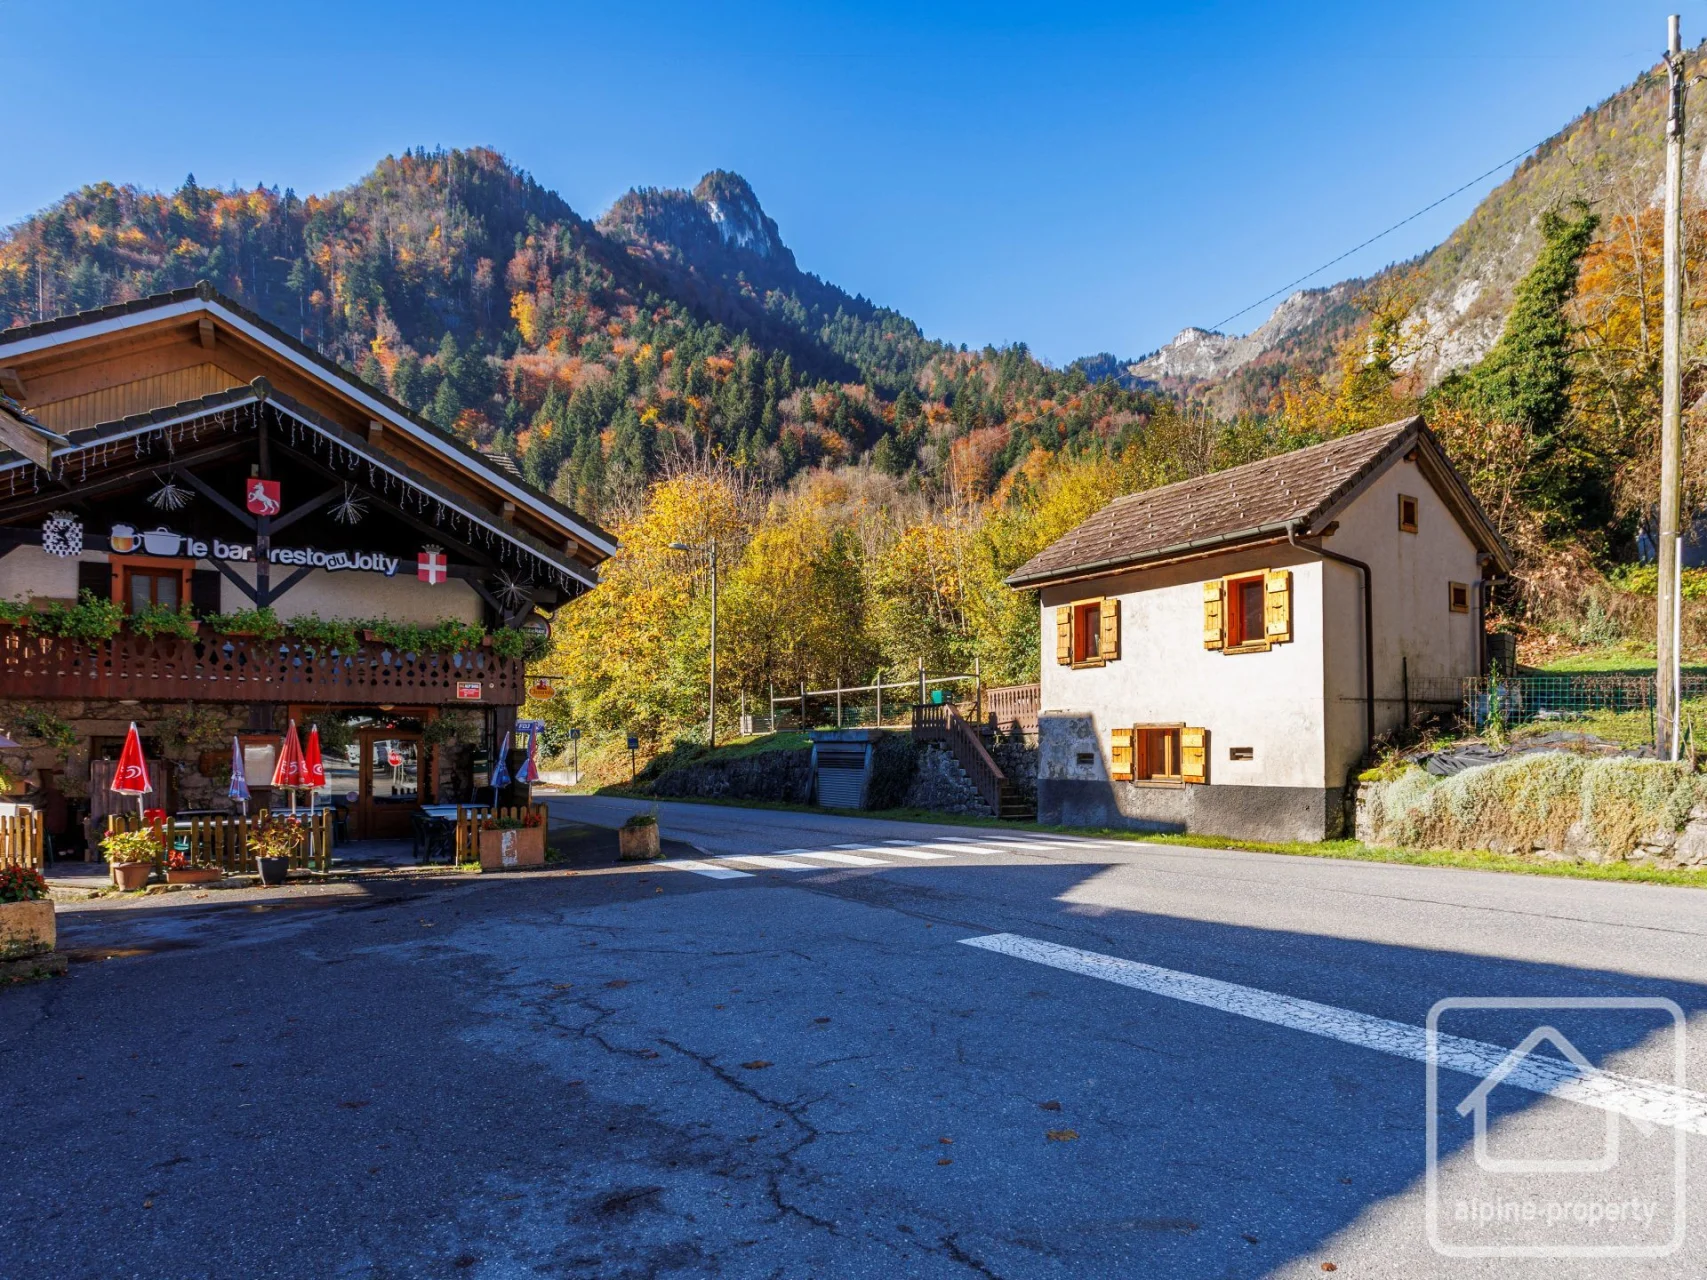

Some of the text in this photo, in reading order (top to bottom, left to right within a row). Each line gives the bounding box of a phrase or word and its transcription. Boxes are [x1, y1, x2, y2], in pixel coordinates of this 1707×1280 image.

[186, 538, 208, 557] le
[270, 547, 327, 566] resto
[327, 555, 346, 567] du
[349, 551, 399, 575] Jotty
